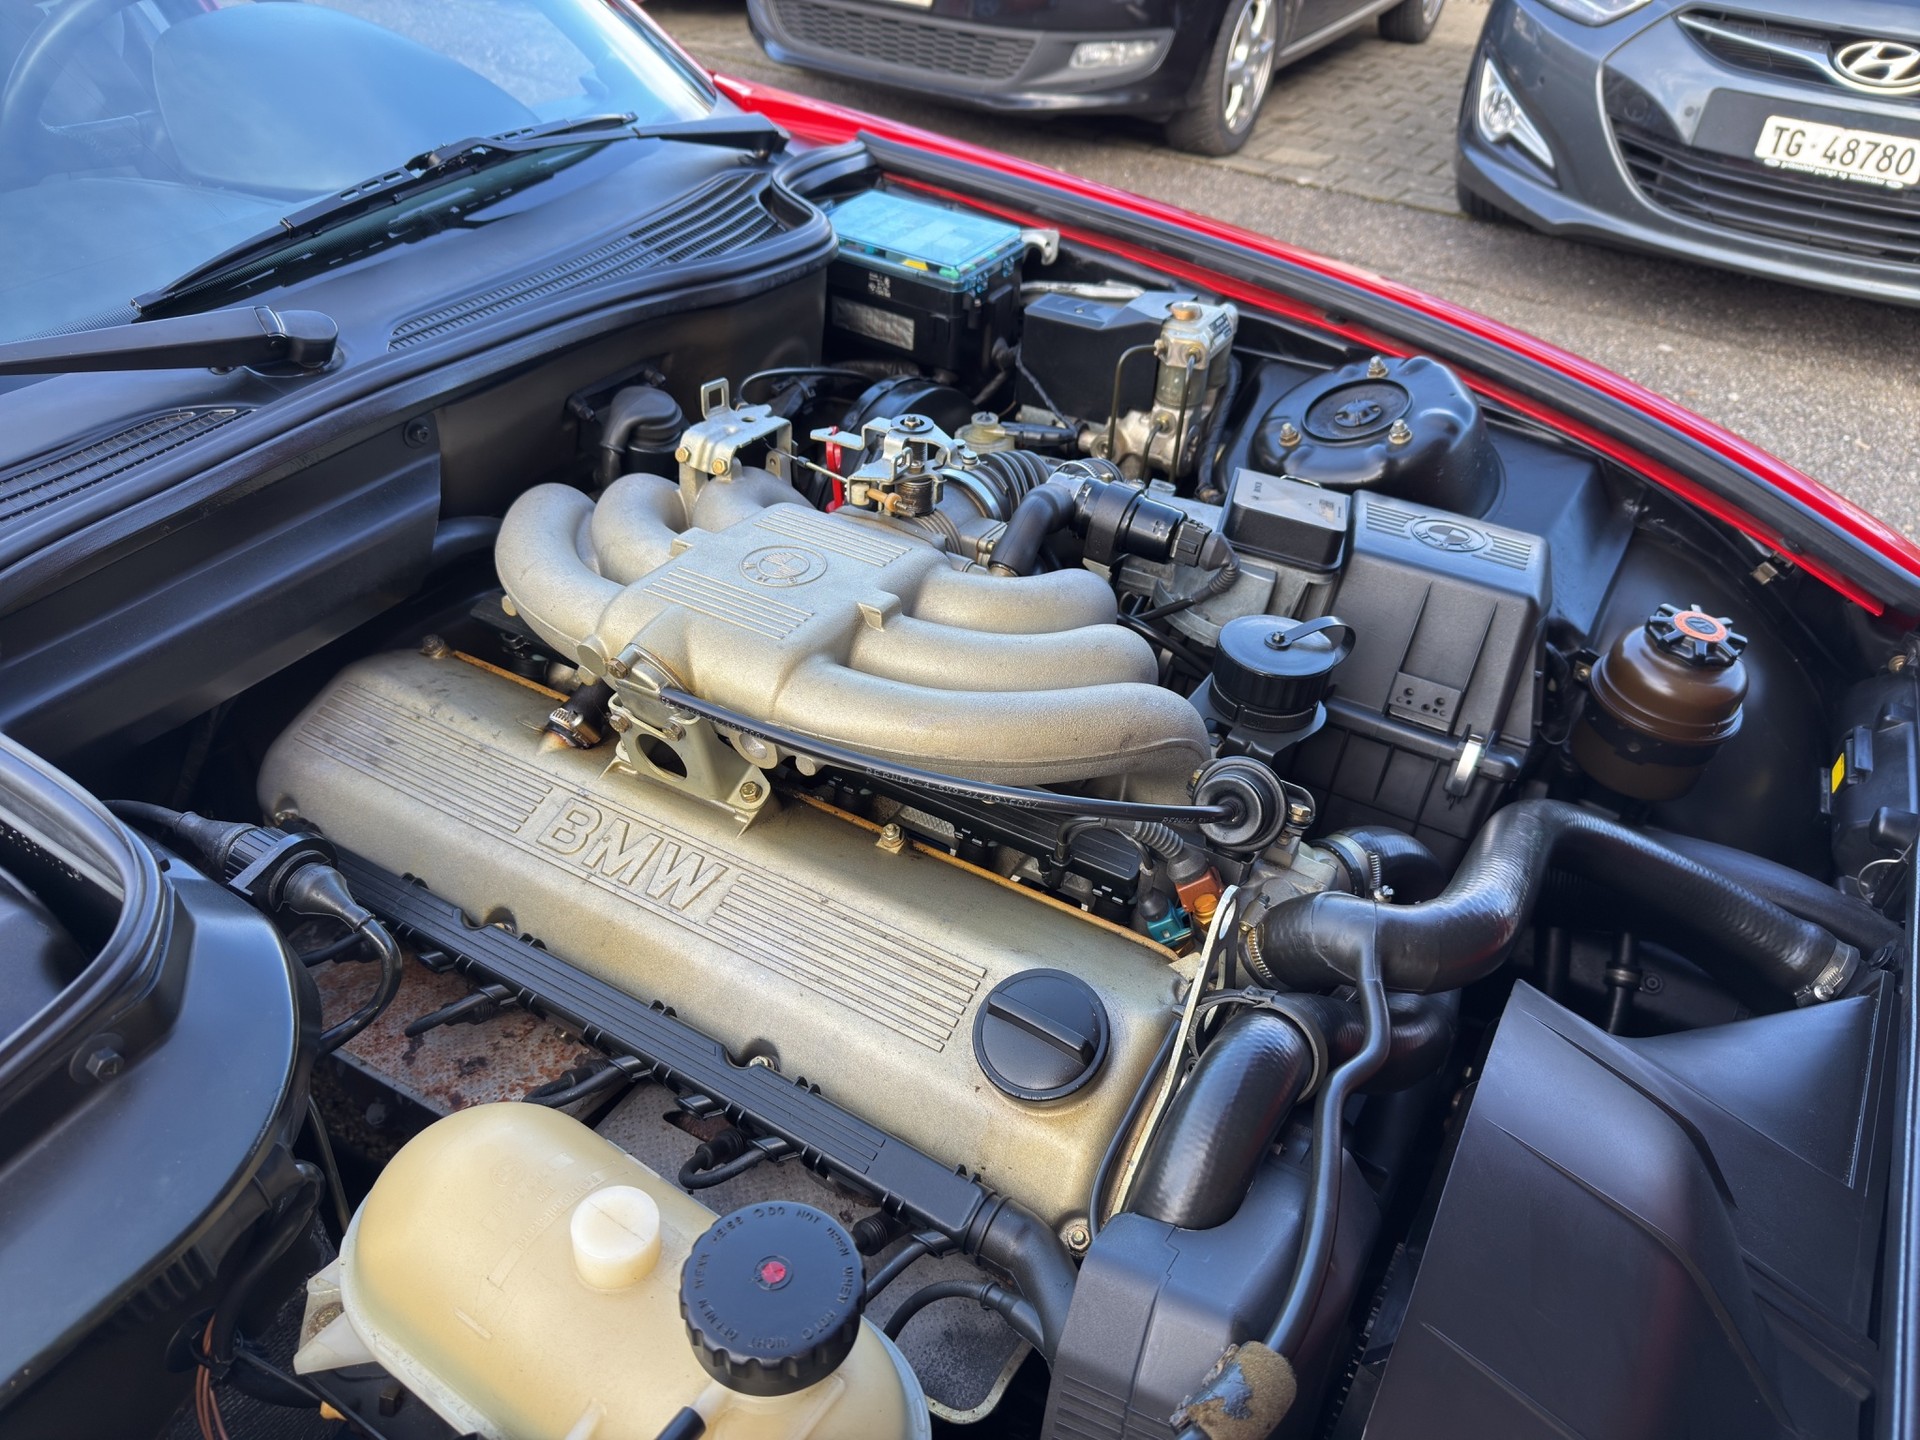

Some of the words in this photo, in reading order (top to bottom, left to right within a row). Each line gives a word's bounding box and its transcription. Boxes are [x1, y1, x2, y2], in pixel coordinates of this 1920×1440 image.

[1772, 126, 1806, 157] TG
[1821, 135, 1916, 176] 48780
[536, 797, 730, 912] BMW
[768, 1206, 785, 1217] DO
[796, 1209, 822, 1224] NOT
[826, 1227, 850, 1257] OPEN
[836, 1266, 854, 1304] WHEN
